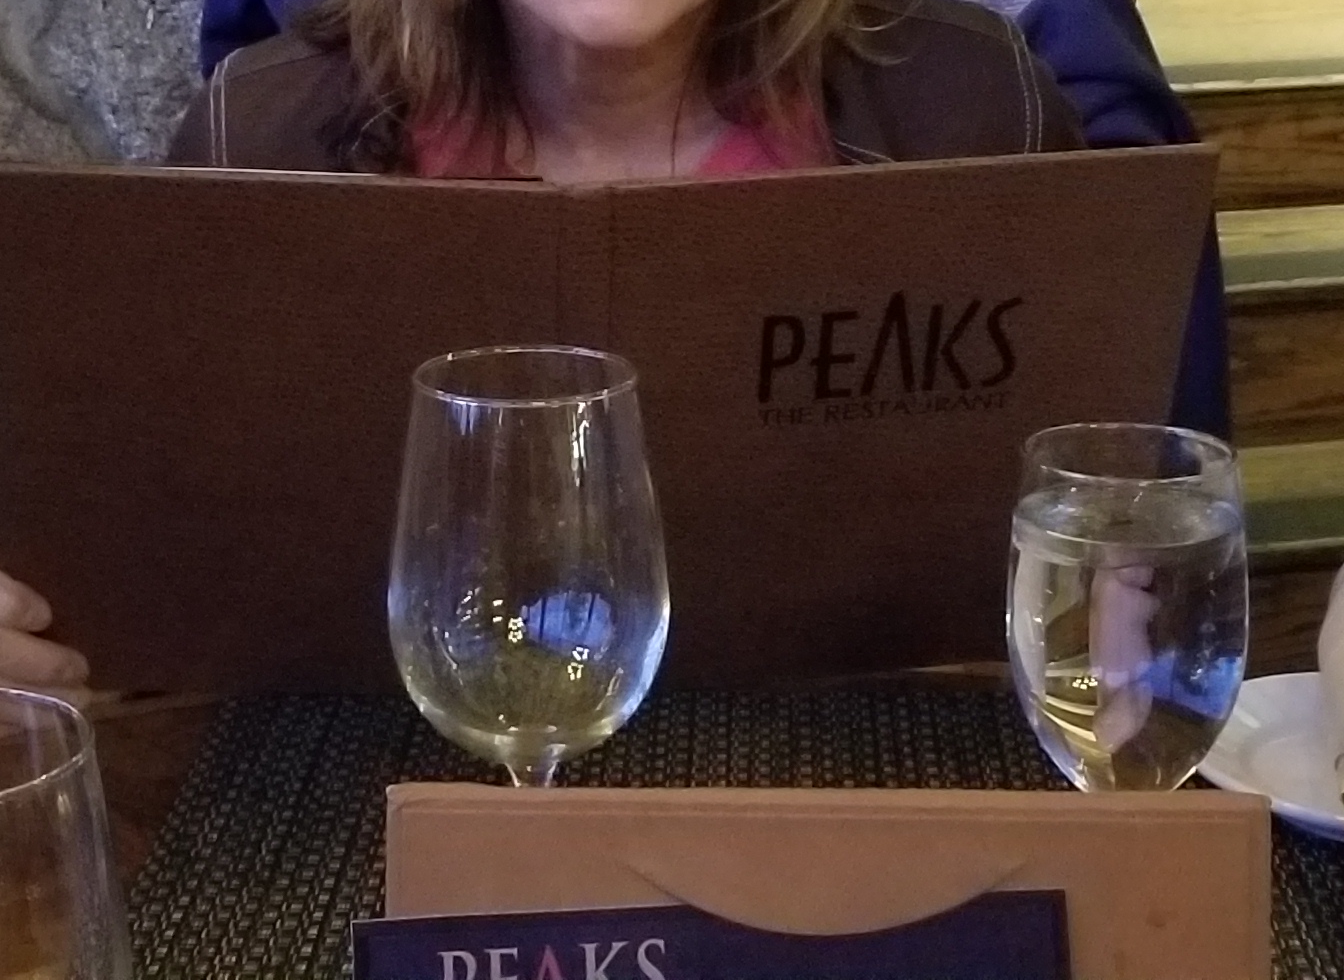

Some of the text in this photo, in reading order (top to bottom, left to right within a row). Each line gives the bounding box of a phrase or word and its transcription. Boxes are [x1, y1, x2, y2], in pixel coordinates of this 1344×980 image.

[758, 290, 1025, 404] PEAKS
[758, 391, 1010, 427] THE RESTAURANT
